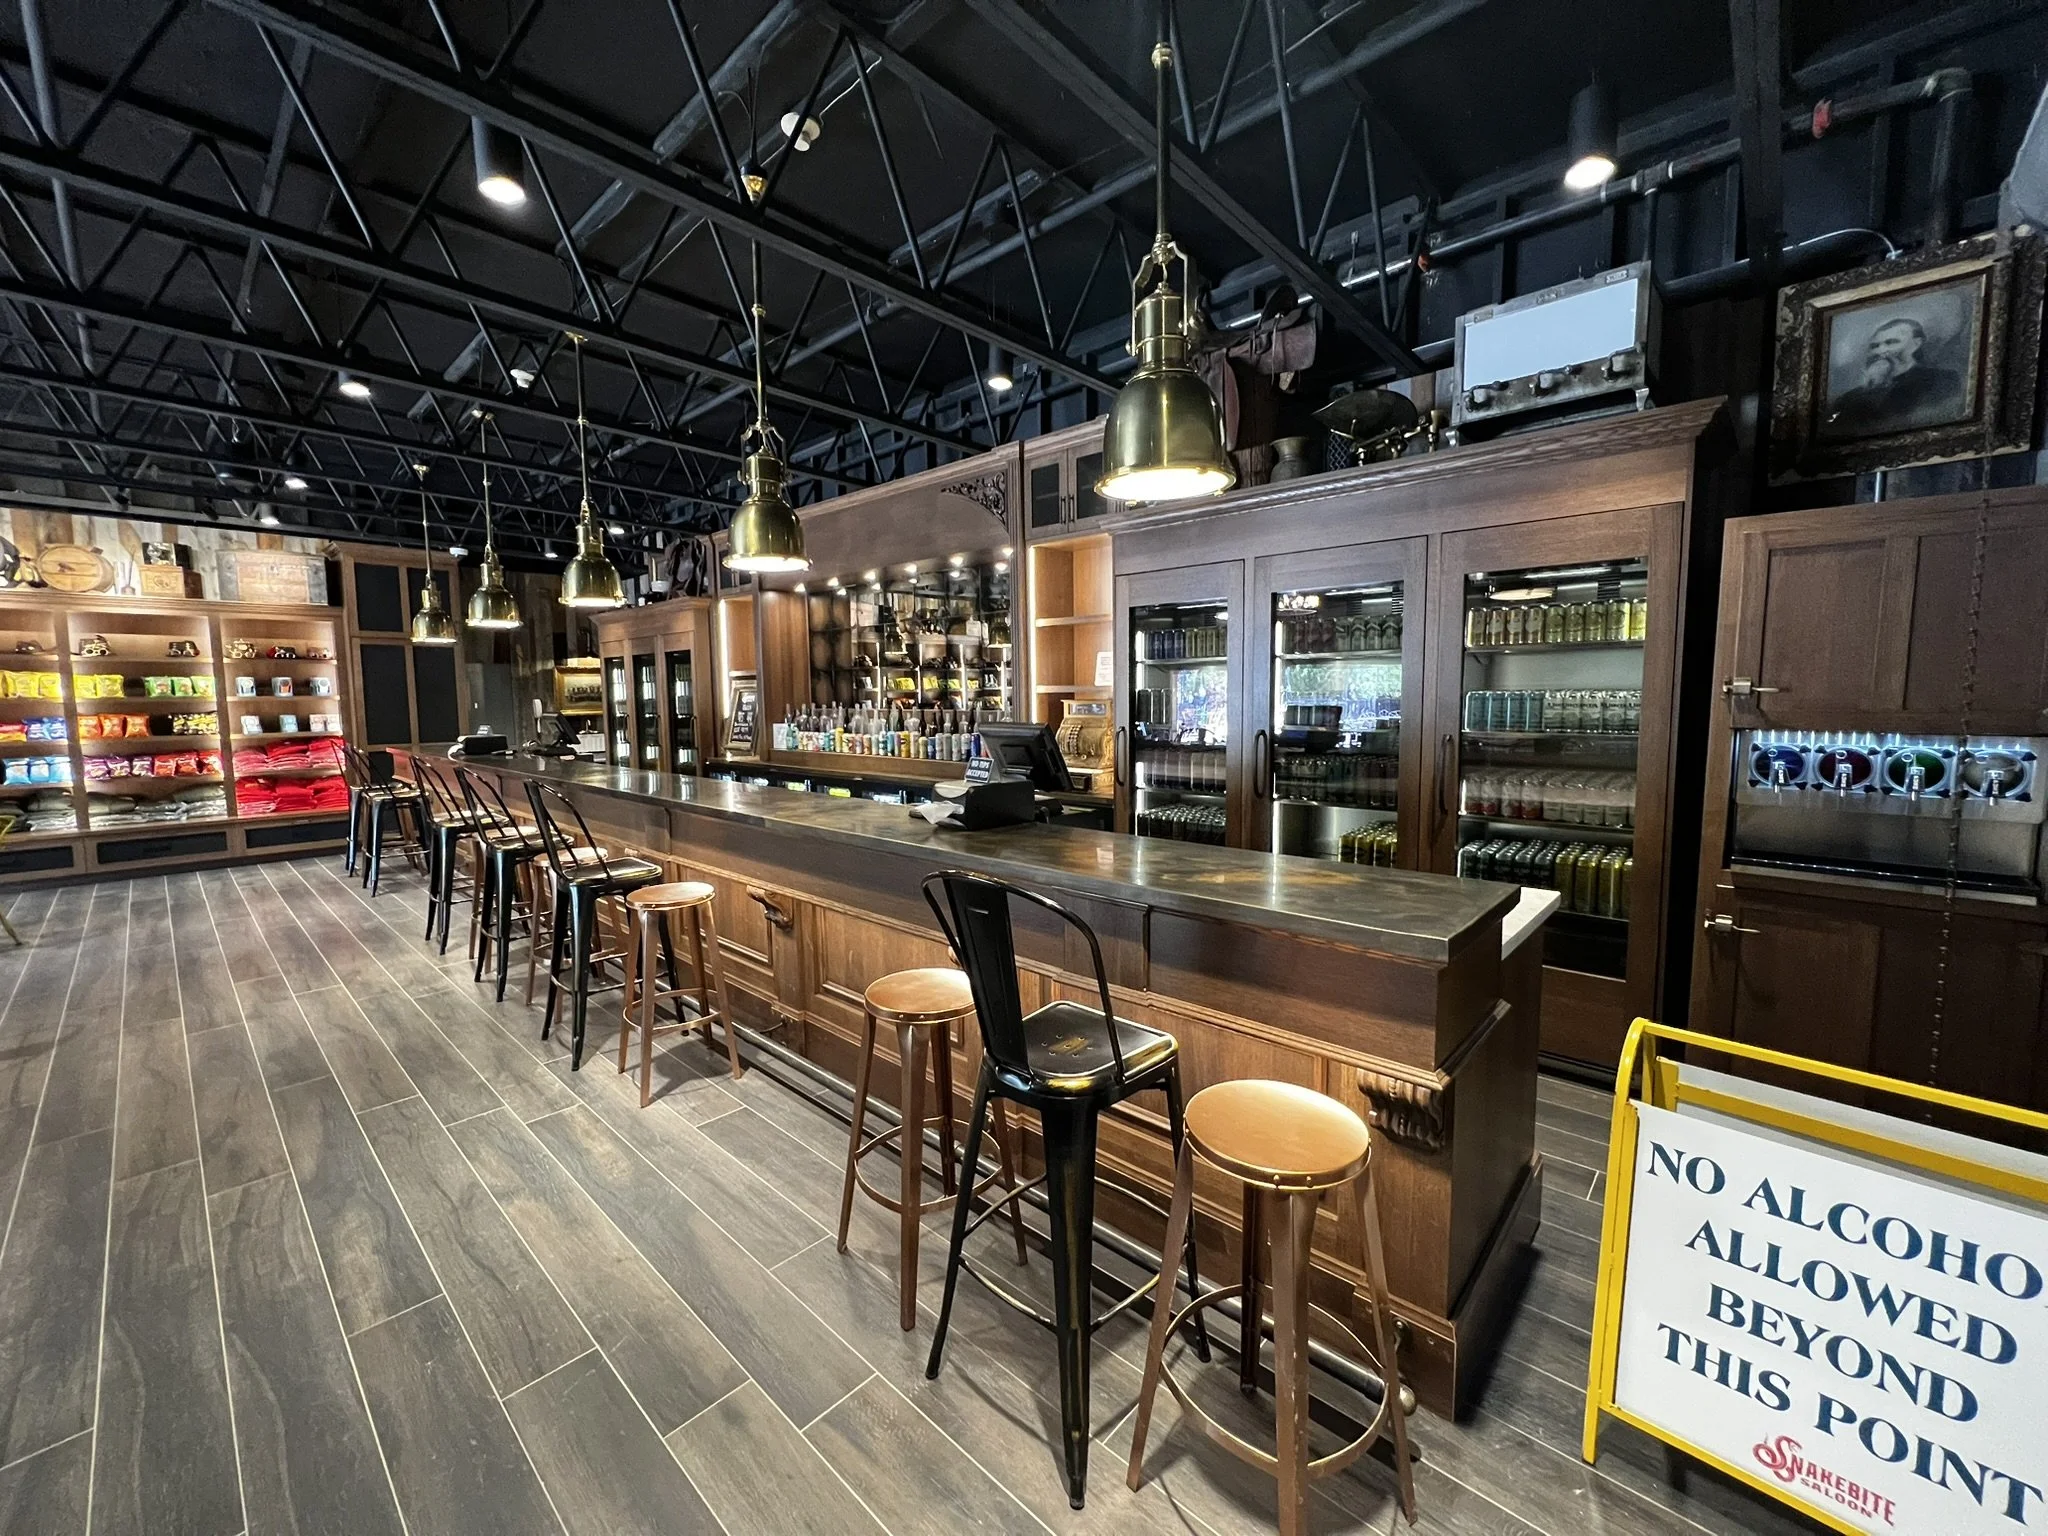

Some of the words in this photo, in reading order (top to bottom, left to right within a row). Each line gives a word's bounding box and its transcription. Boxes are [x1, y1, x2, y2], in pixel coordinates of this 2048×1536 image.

[1647, 1141, 1726, 1195] NO
[1742, 1177, 2048, 1308] ALCOHO
[1685, 1219, 2018, 1365] ALLOWED
[1706, 1282, 1979, 1422] BEYOND
[1657, 1322, 1791, 1411] THIS
[1813, 1391, 2045, 1527] POINT
[1752, 1435, 1896, 1527] SNAKEBITE
[1800, 1477, 1872, 1519] SALOON
